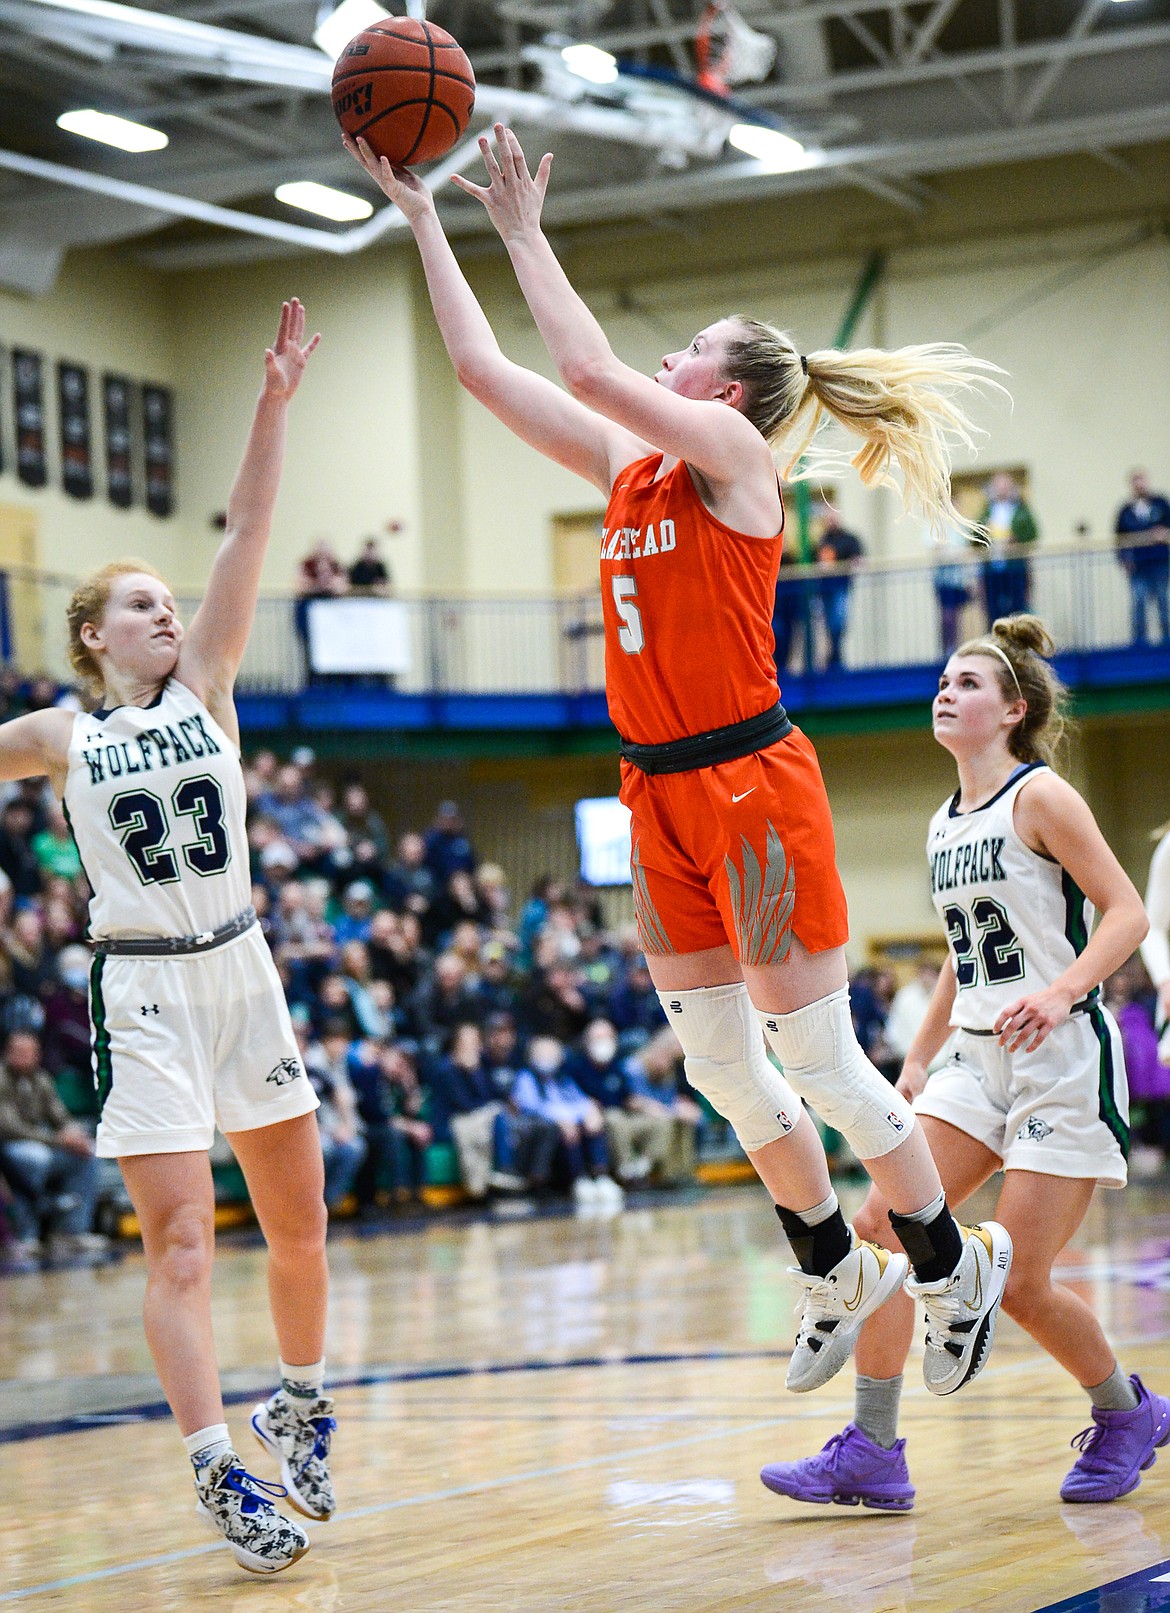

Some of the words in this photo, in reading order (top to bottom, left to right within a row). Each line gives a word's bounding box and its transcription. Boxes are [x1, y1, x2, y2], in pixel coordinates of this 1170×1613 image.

[612, 575, 645, 655] 5
[82, 713, 221, 785] WOLFPACK
[107, 773, 232, 886] 23
[943, 896, 1025, 991] 22
